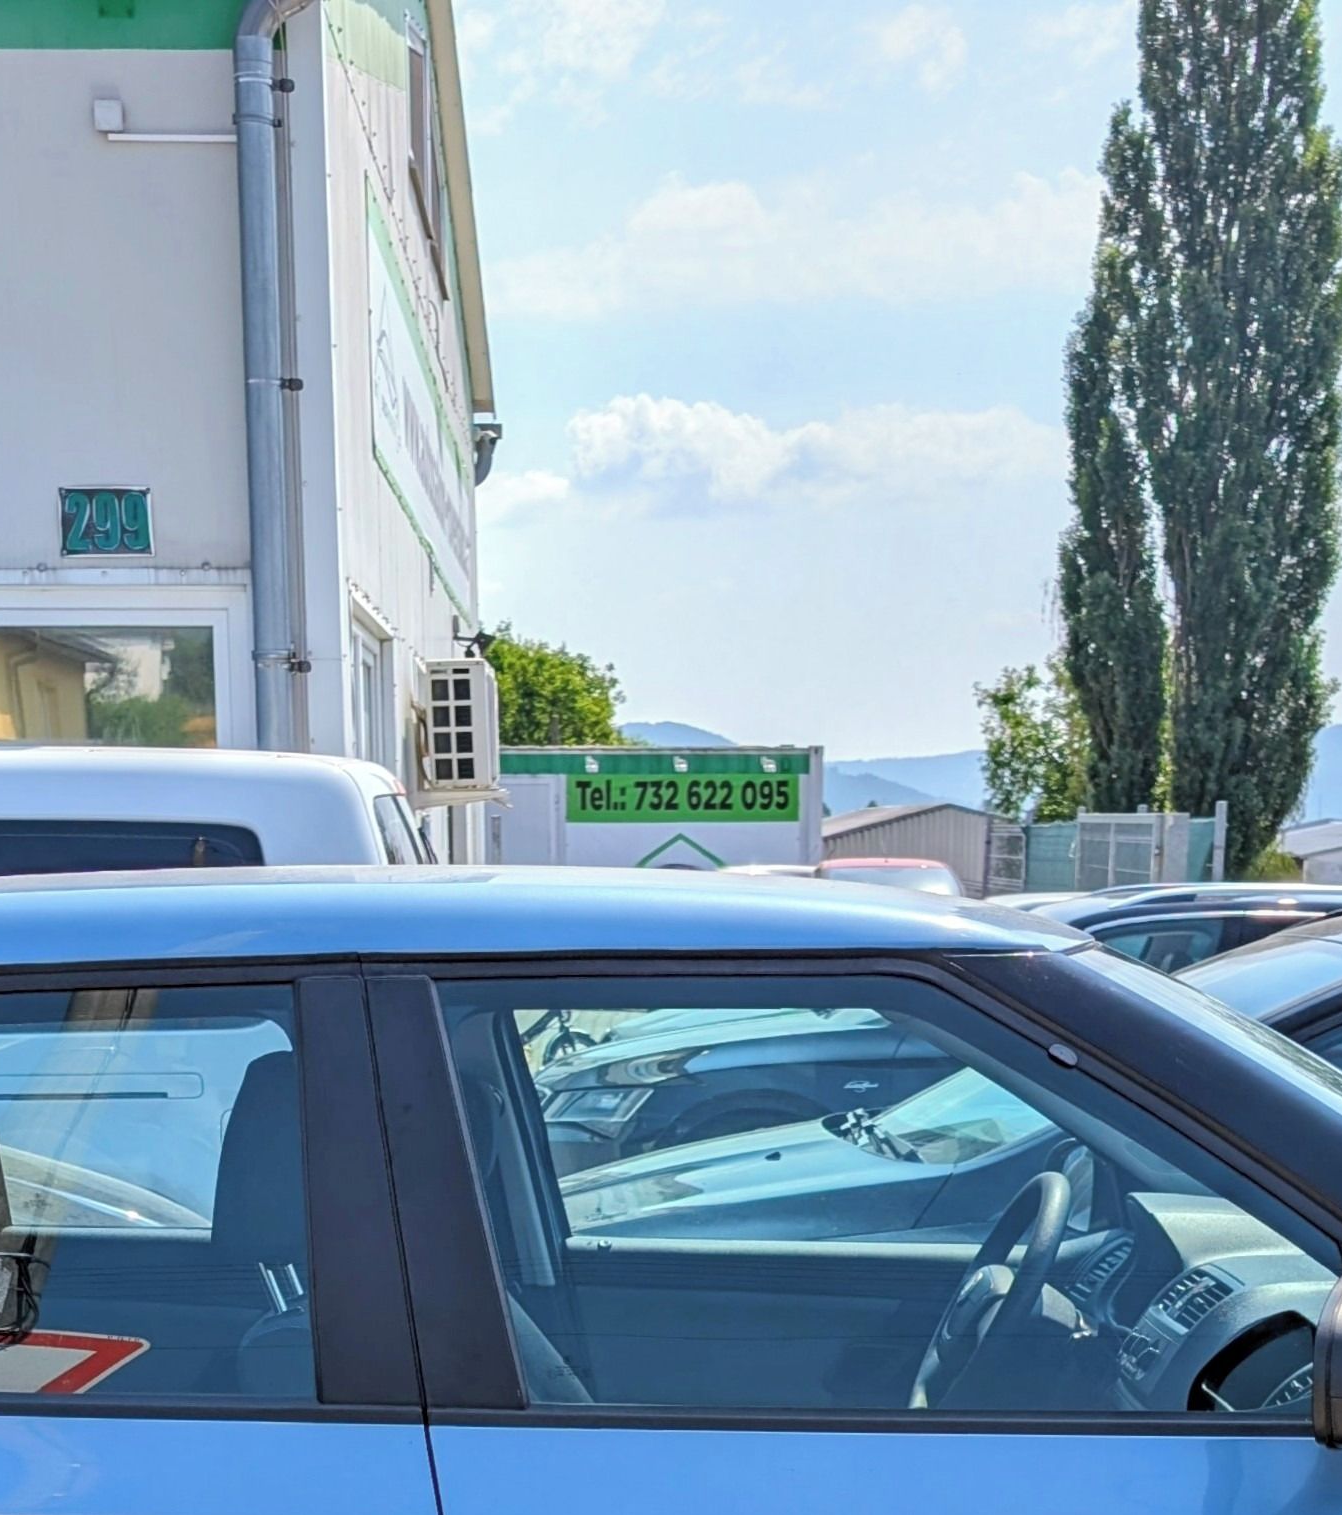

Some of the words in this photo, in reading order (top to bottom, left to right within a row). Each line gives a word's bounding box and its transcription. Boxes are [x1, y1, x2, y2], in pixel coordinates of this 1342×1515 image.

[65, 491, 150, 550] 299
[575, 779, 627, 811] Tel.:
[634, 780, 679, 811] 732
[687, 780, 734, 811] 622
[741, 780, 790, 811] 095
